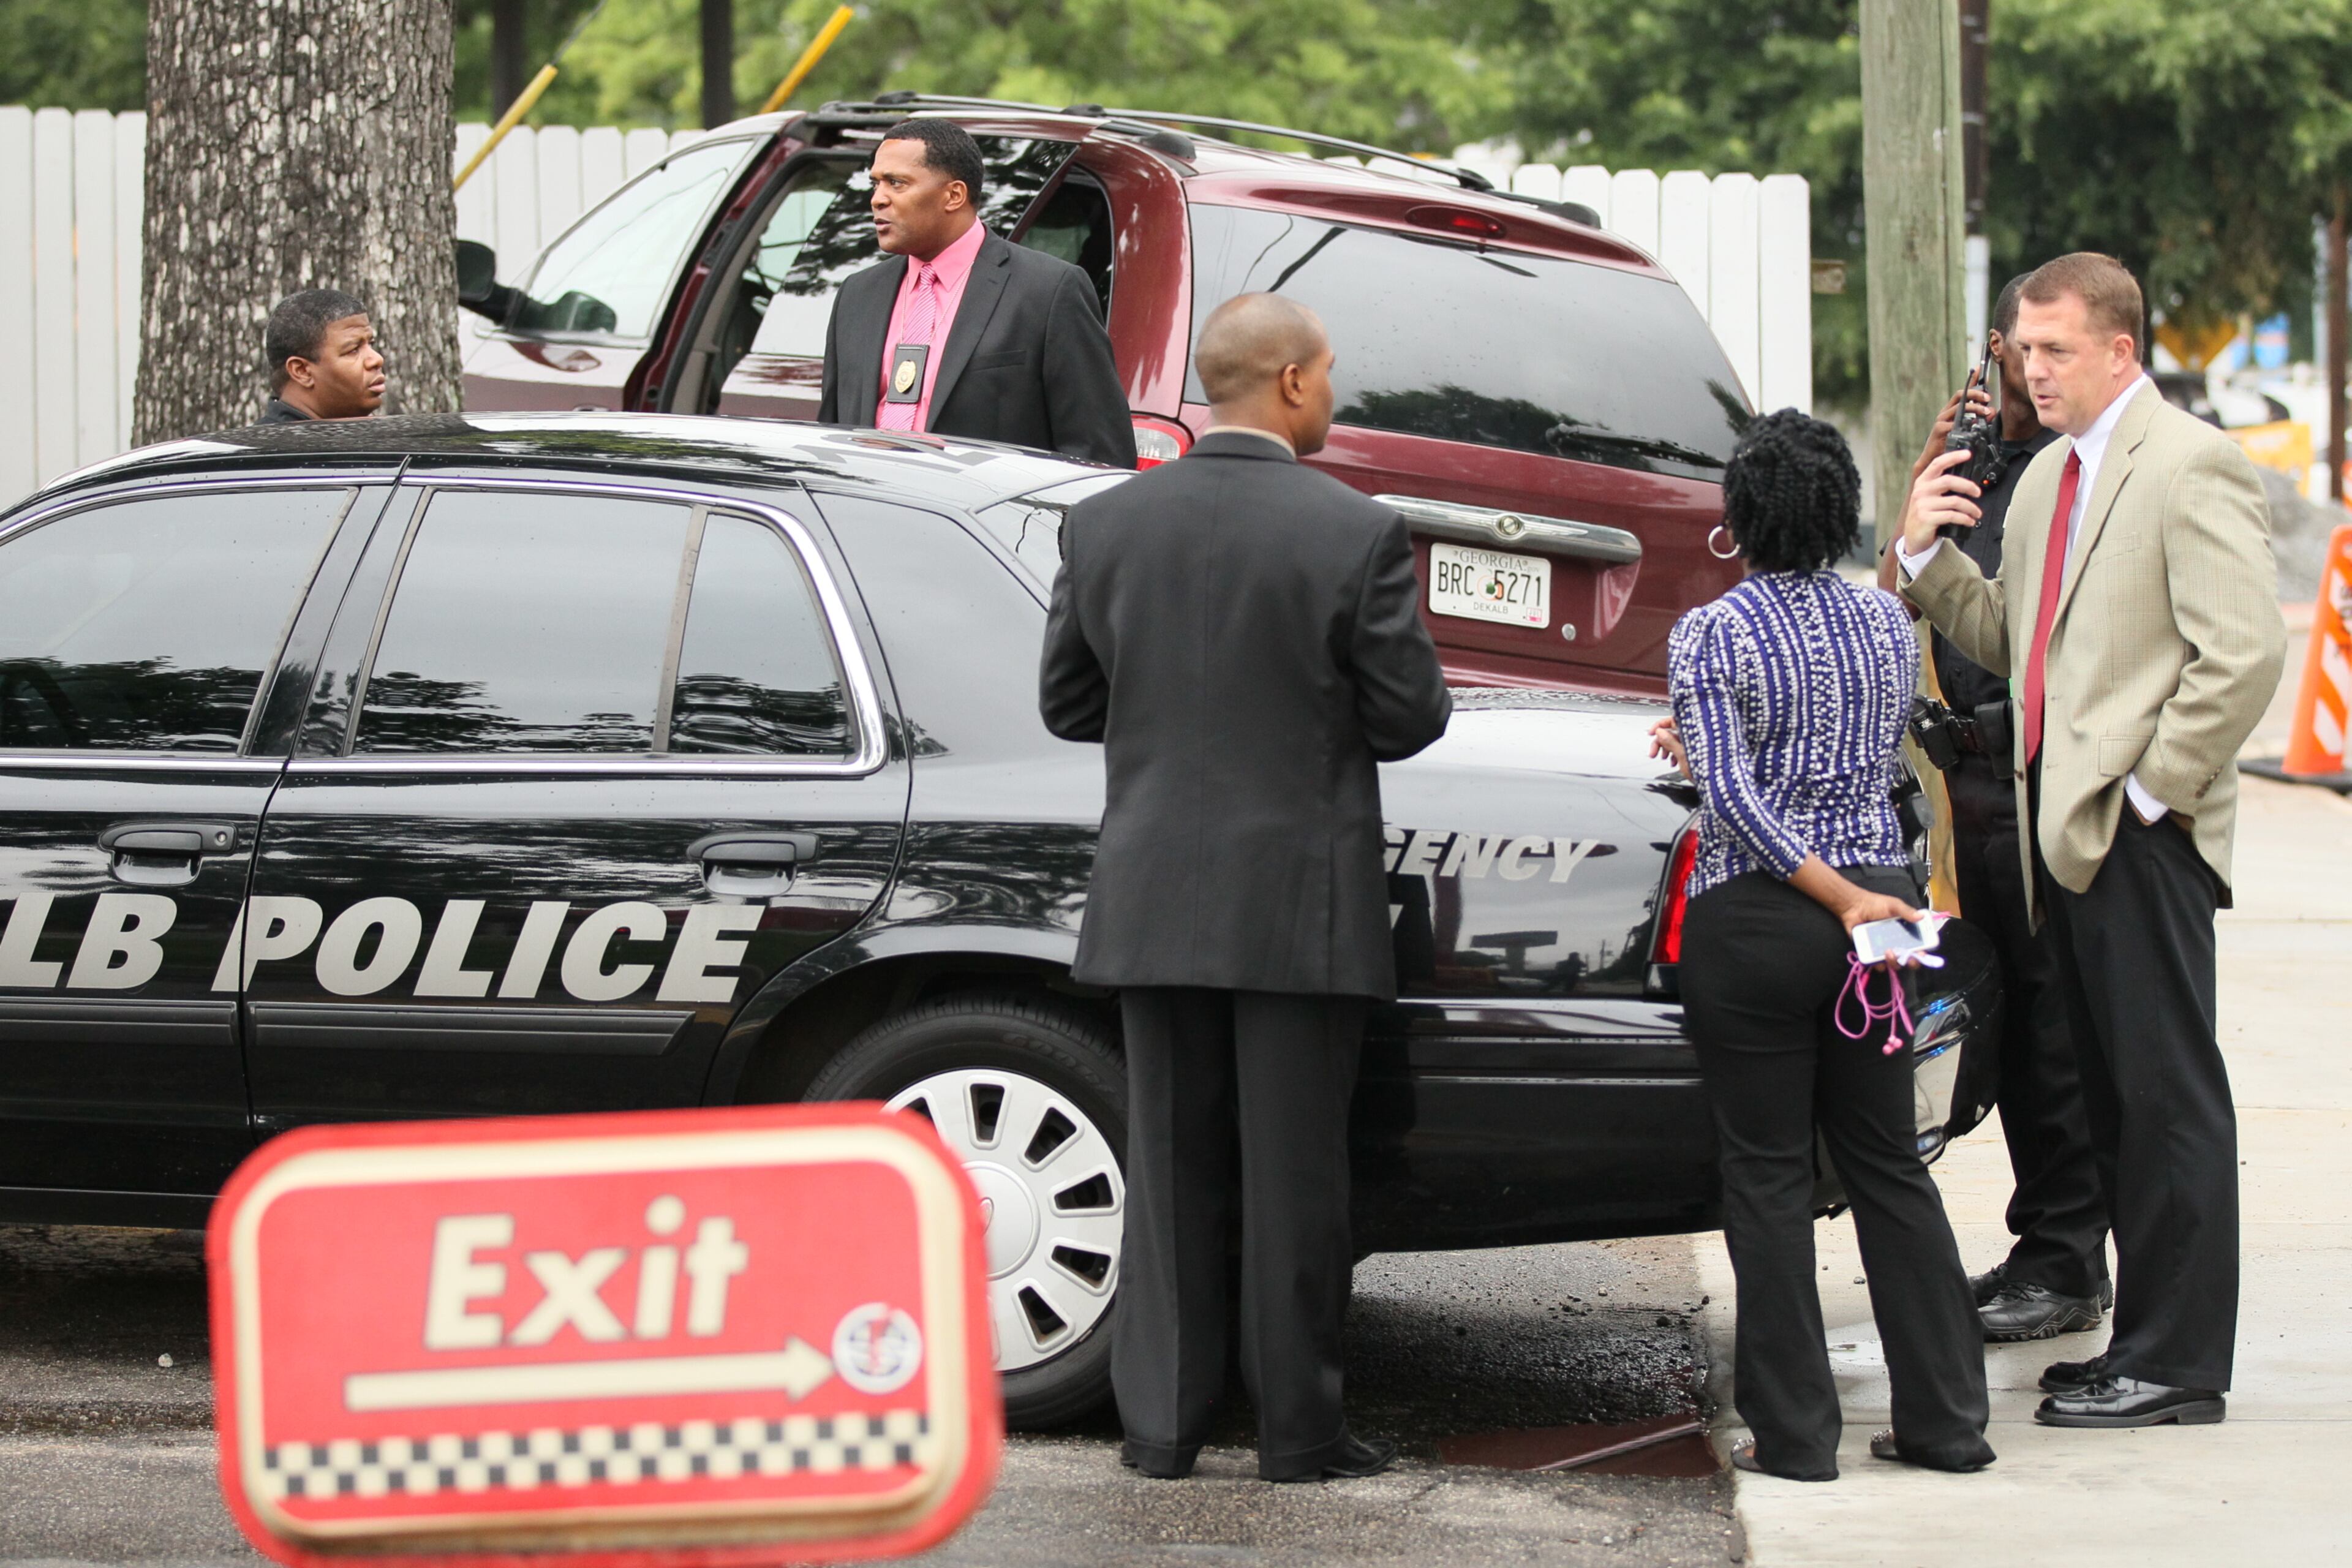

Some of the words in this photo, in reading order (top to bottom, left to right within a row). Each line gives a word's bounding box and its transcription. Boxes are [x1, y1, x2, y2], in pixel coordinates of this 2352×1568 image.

[1438, 561, 1474, 596] BRC
[1494, 570, 1541, 607] 5271
[1473, 601, 1509, 614] DEKALB
[210, 895, 766, 1003] POLICE
[423, 1194, 750, 1350] Exit
